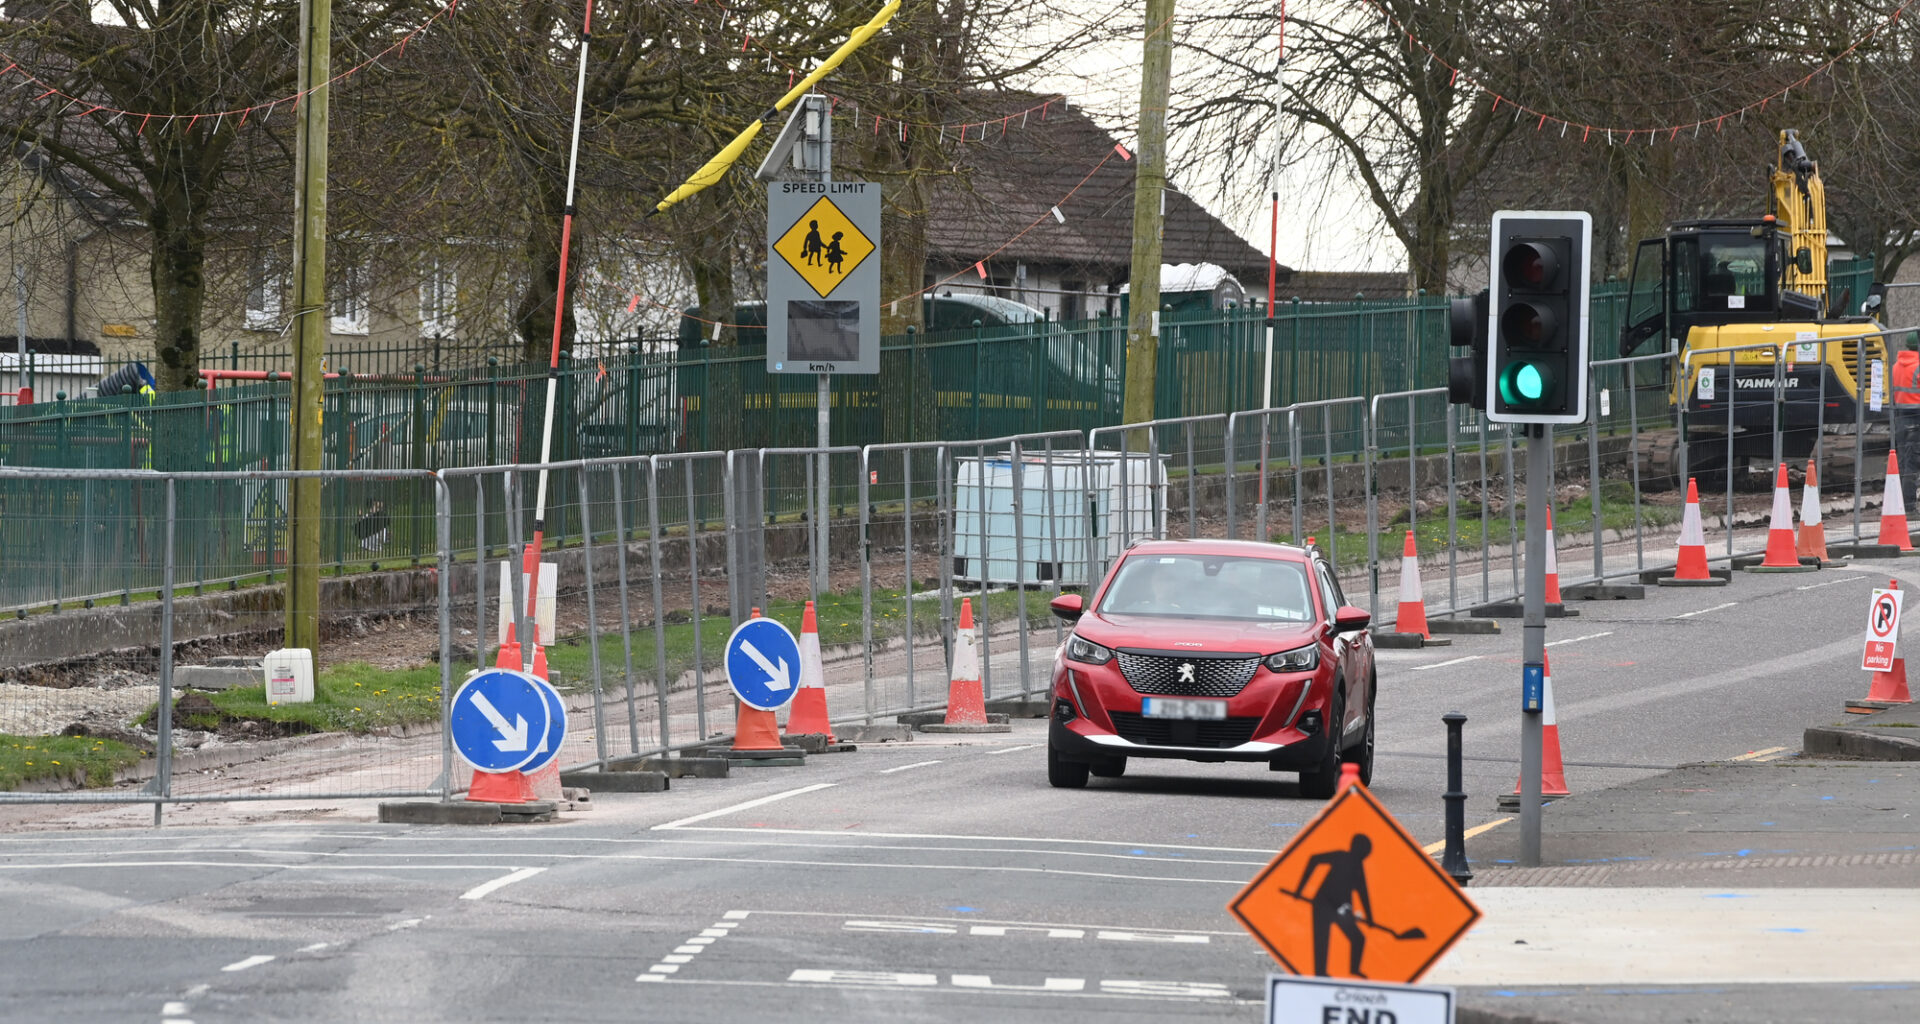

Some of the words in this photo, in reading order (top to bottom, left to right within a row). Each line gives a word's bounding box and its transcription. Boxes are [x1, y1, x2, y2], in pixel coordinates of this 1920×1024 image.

[782, 183, 827, 194] SPEED
[831, 183, 866, 194] LIMIT
[809, 362, 835, 372] km/h
[1875, 643, 1884, 653] No
[1866, 655, 1889, 666] parking
[1322, 1006, 1397, 1024] END
